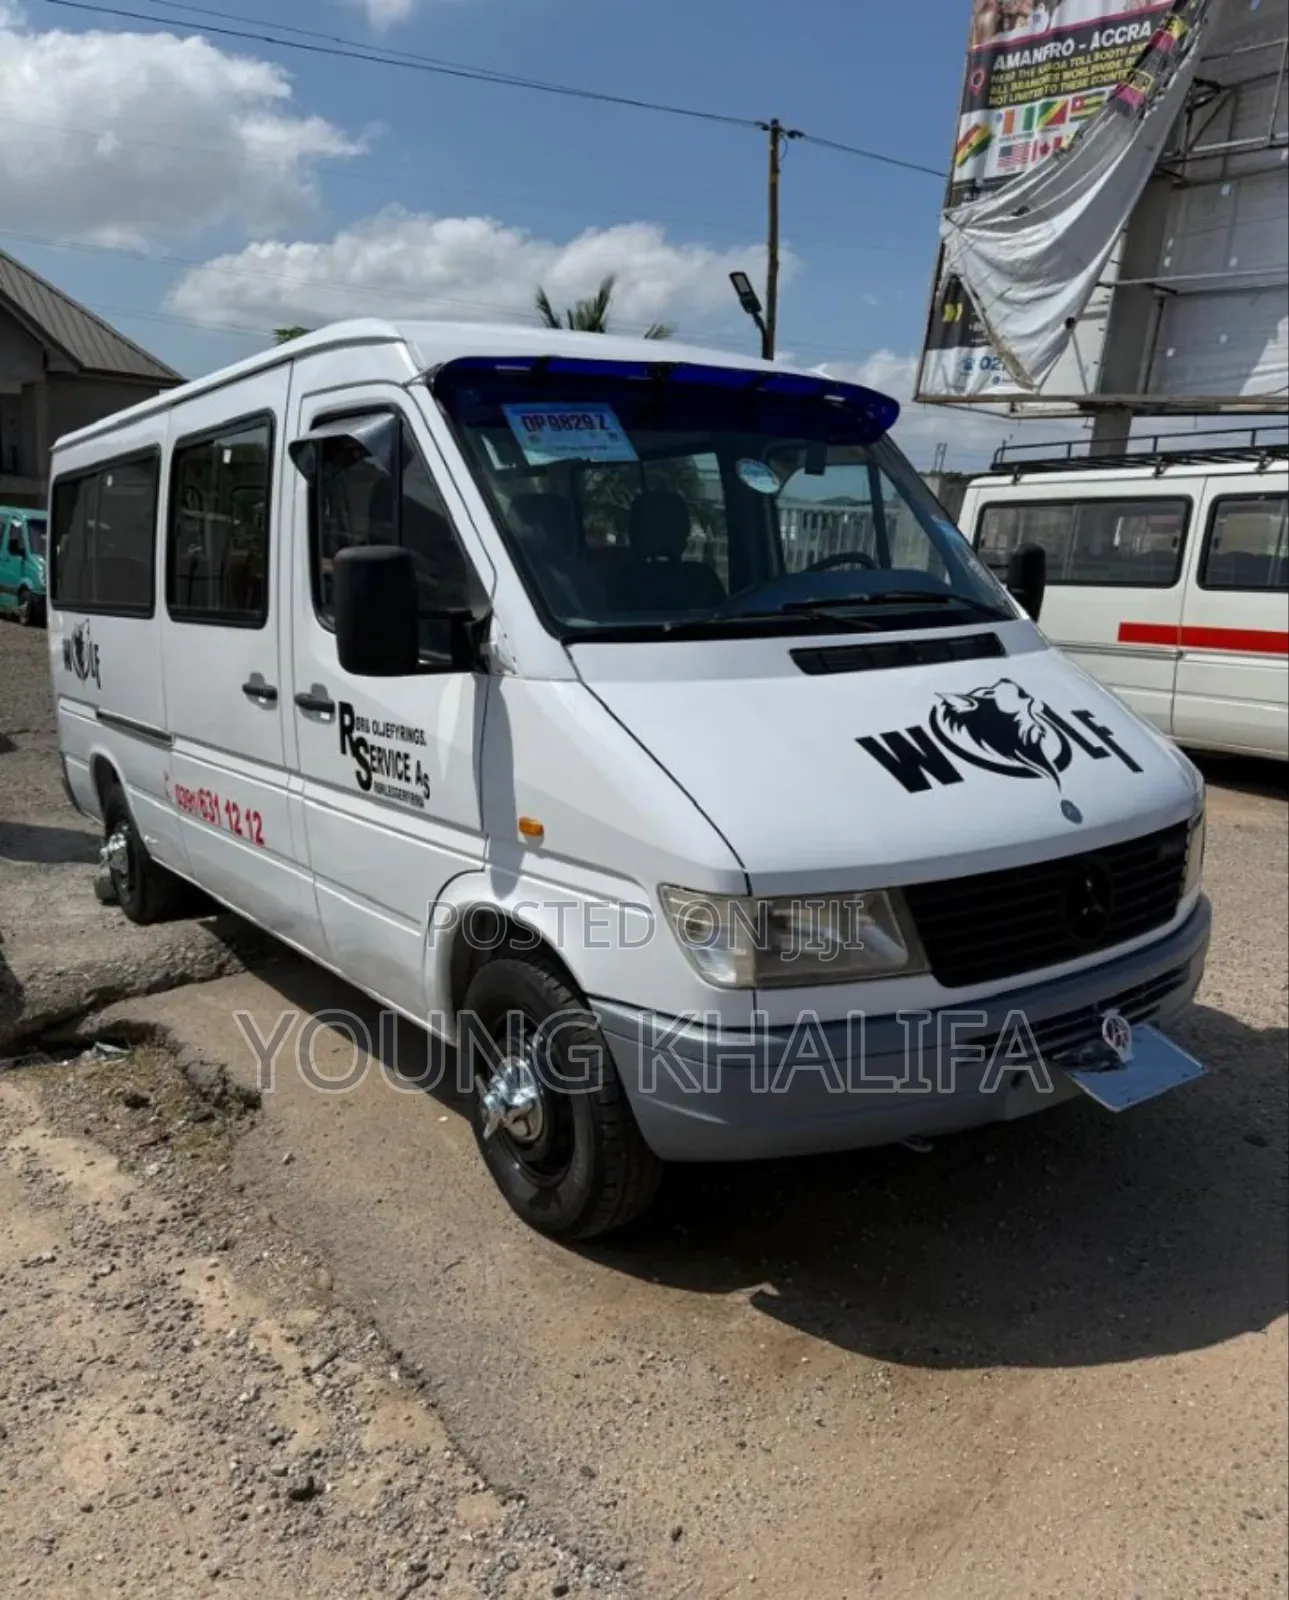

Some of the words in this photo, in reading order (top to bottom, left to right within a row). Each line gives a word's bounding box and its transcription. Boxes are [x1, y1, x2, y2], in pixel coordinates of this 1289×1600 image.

[993, 38, 1075, 70] AMANFRO
[1090, 21, 1151, 51] ACCRA
[1018, 66, 1035, 79] THE
[1070, 54, 1092, 69] TOLL
[1094, 47, 1126, 63] BOOTH
[1062, 60, 1122, 81] WORLDWIDE
[354, 736, 412, 792] SERVICE
[224, 799, 242, 836] 12
[245, 807, 265, 846] 12
